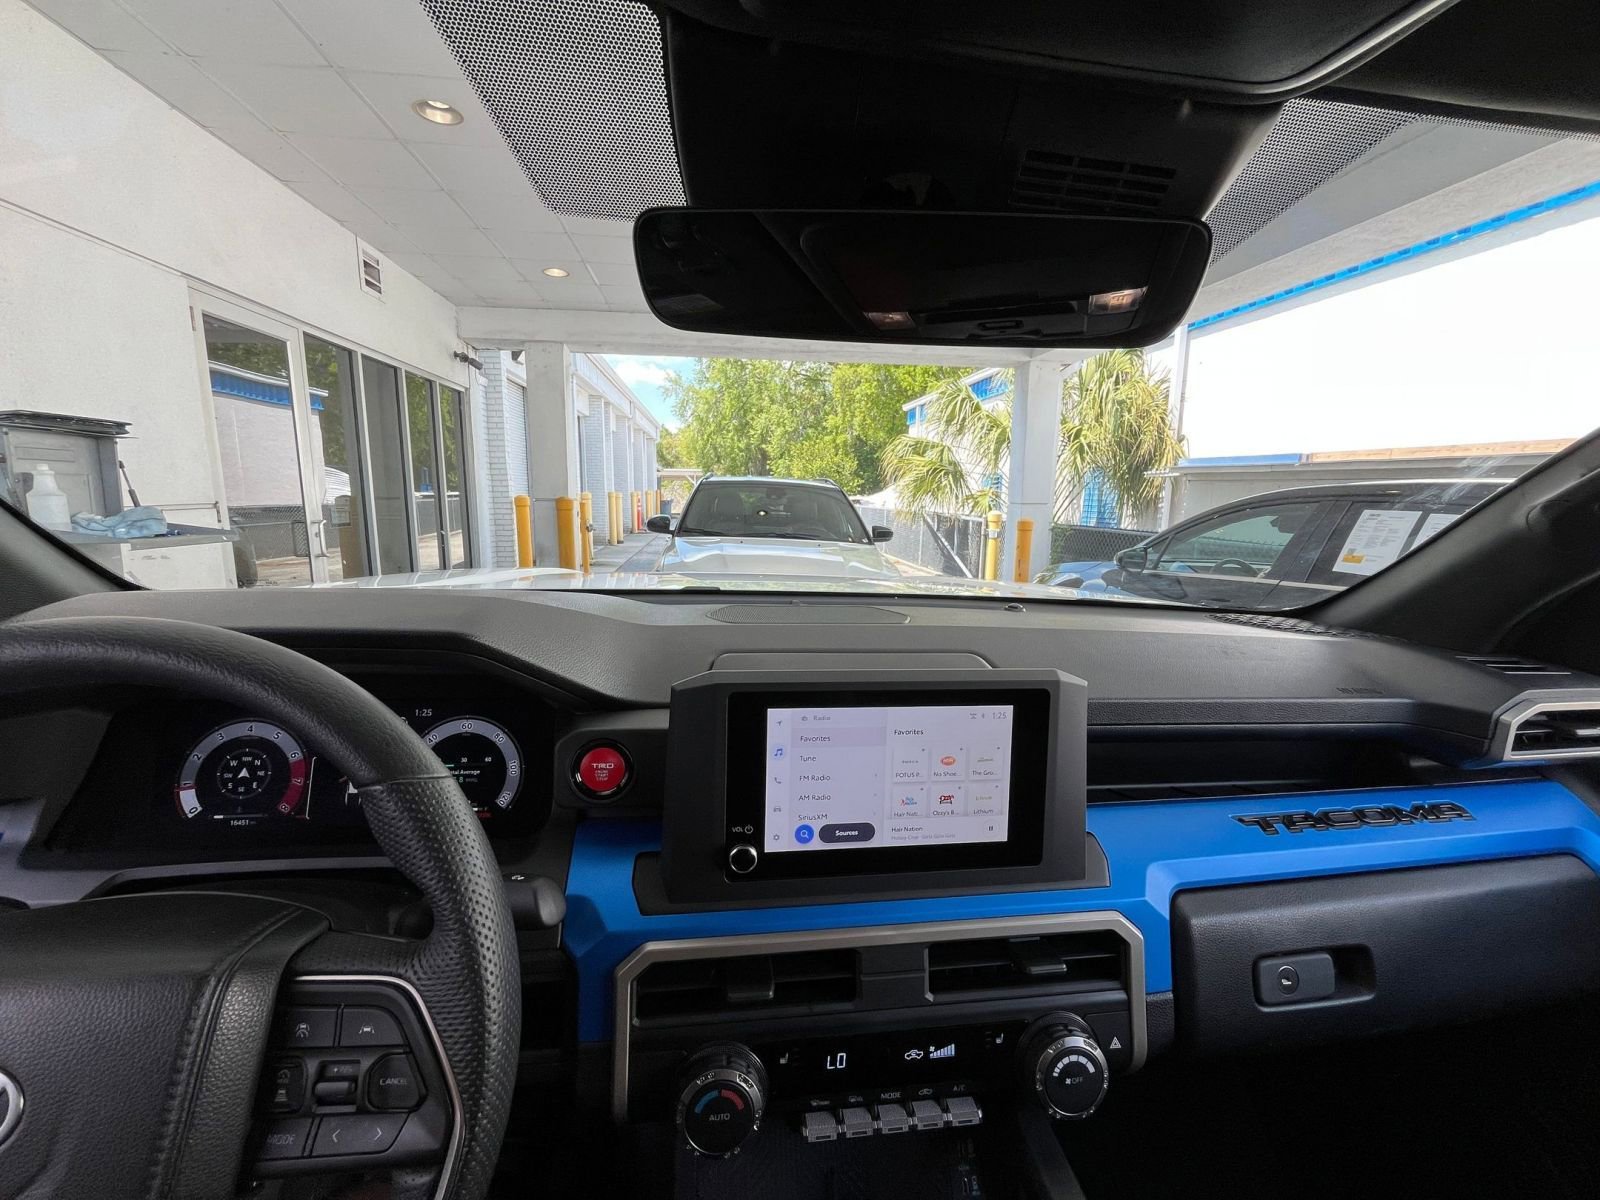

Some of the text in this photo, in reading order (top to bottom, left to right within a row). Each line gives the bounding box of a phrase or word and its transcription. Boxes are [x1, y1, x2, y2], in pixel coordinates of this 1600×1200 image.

[415, 709, 432, 717] 1:25
[992, 712, 1007, 720] 1:25
[461, 722, 473, 730] 60
[216, 732, 226, 741] 3
[273, 732, 282, 740] 5
[894, 728, 924, 736] Favorites
[427, 734, 438, 744] 40
[494, 732, 505, 743] 80
[192, 753, 202, 761] 2
[290, 751, 300, 759] 6
[510, 760, 518, 776] 100
[498, 791, 511, 806] 120
[1231, 800, 1476, 835] TACOMA
[826, 1053, 846, 1070] LO
[380, 1078, 407, 1086] CANCEL
[881, 1091, 902, 1100] MODE
[709, 1112, 731, 1121] AUTO
